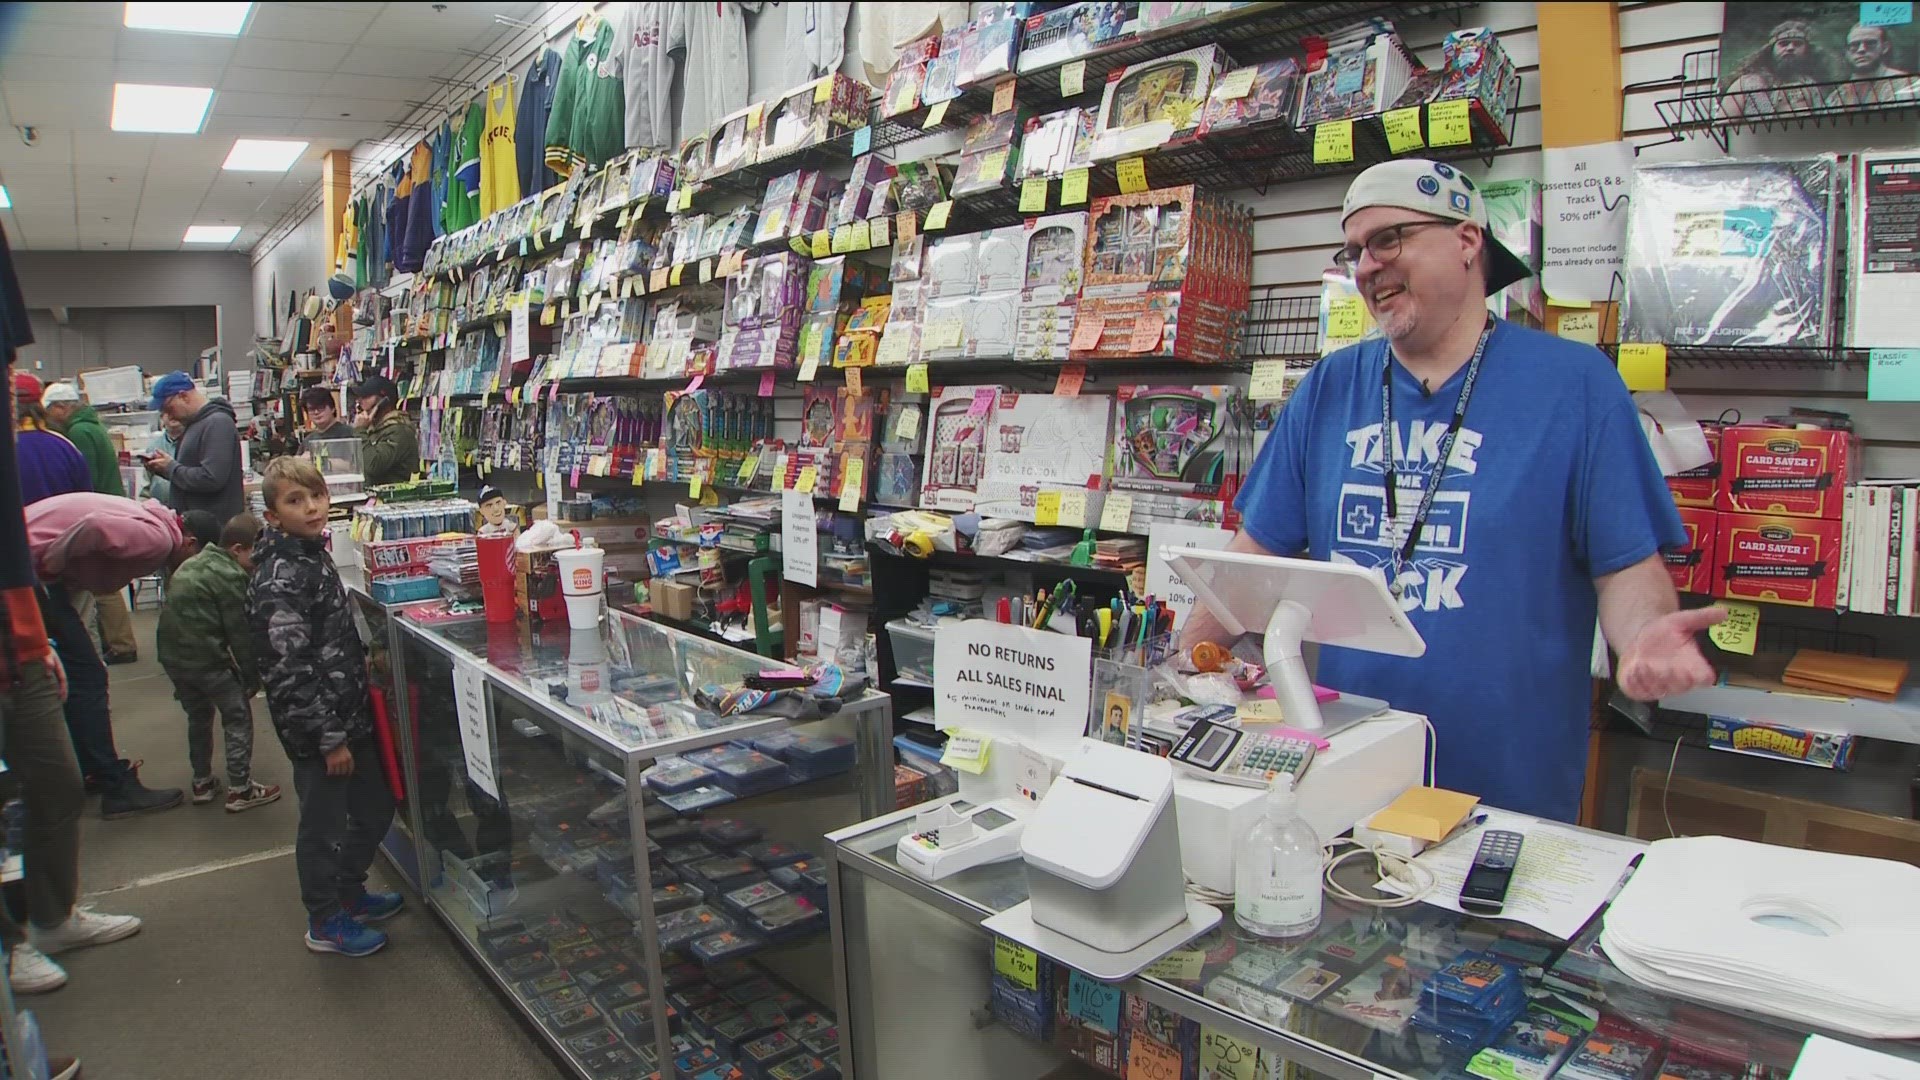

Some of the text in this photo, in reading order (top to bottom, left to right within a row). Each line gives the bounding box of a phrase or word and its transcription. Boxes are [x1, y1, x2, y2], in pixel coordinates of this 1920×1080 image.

[1574, 162, 1587, 172] All
[1584, 178, 1601, 188] CDs
[1604, 176, 1612, 186] &
[1615, 176, 1625, 186] 8-
[1566, 194, 1596, 205] Tracks
[1559, 212, 1581, 222] 50%
[1572, 245, 1586, 253] not
[1587, 244, 1617, 253] include
[1564, 258, 1593, 268] already
[1607, 256, 1623, 265] sale
[1715, 326, 1758, 337] LIGHTNIN
[1620, 347, 1649, 355] metal
[1346, 420, 1483, 475] TAKE
[1746, 455, 1773, 465] CARD
[1774, 456, 1808, 467] SAVER
[1396, 474, 1422, 489] ME
[1891, 510, 1901, 539] TDK
[1739, 541, 1766, 551] CARD
[1767, 542, 1801, 555] SAVER
[1168, 593, 1186, 603] 10%
[1717, 630, 1743, 645] $25
[968, 642, 1055, 672] NO RETURNS
[957, 669, 1066, 702] ALL SALES FINAL
[961, 694, 998, 706] minimum
[1015, 703, 1034, 714] credit
[1037, 708, 1055, 717] card
[1733, 727, 1806, 755] BASEBALL
[1261, 893, 1304, 902] Hand Sanitizer
